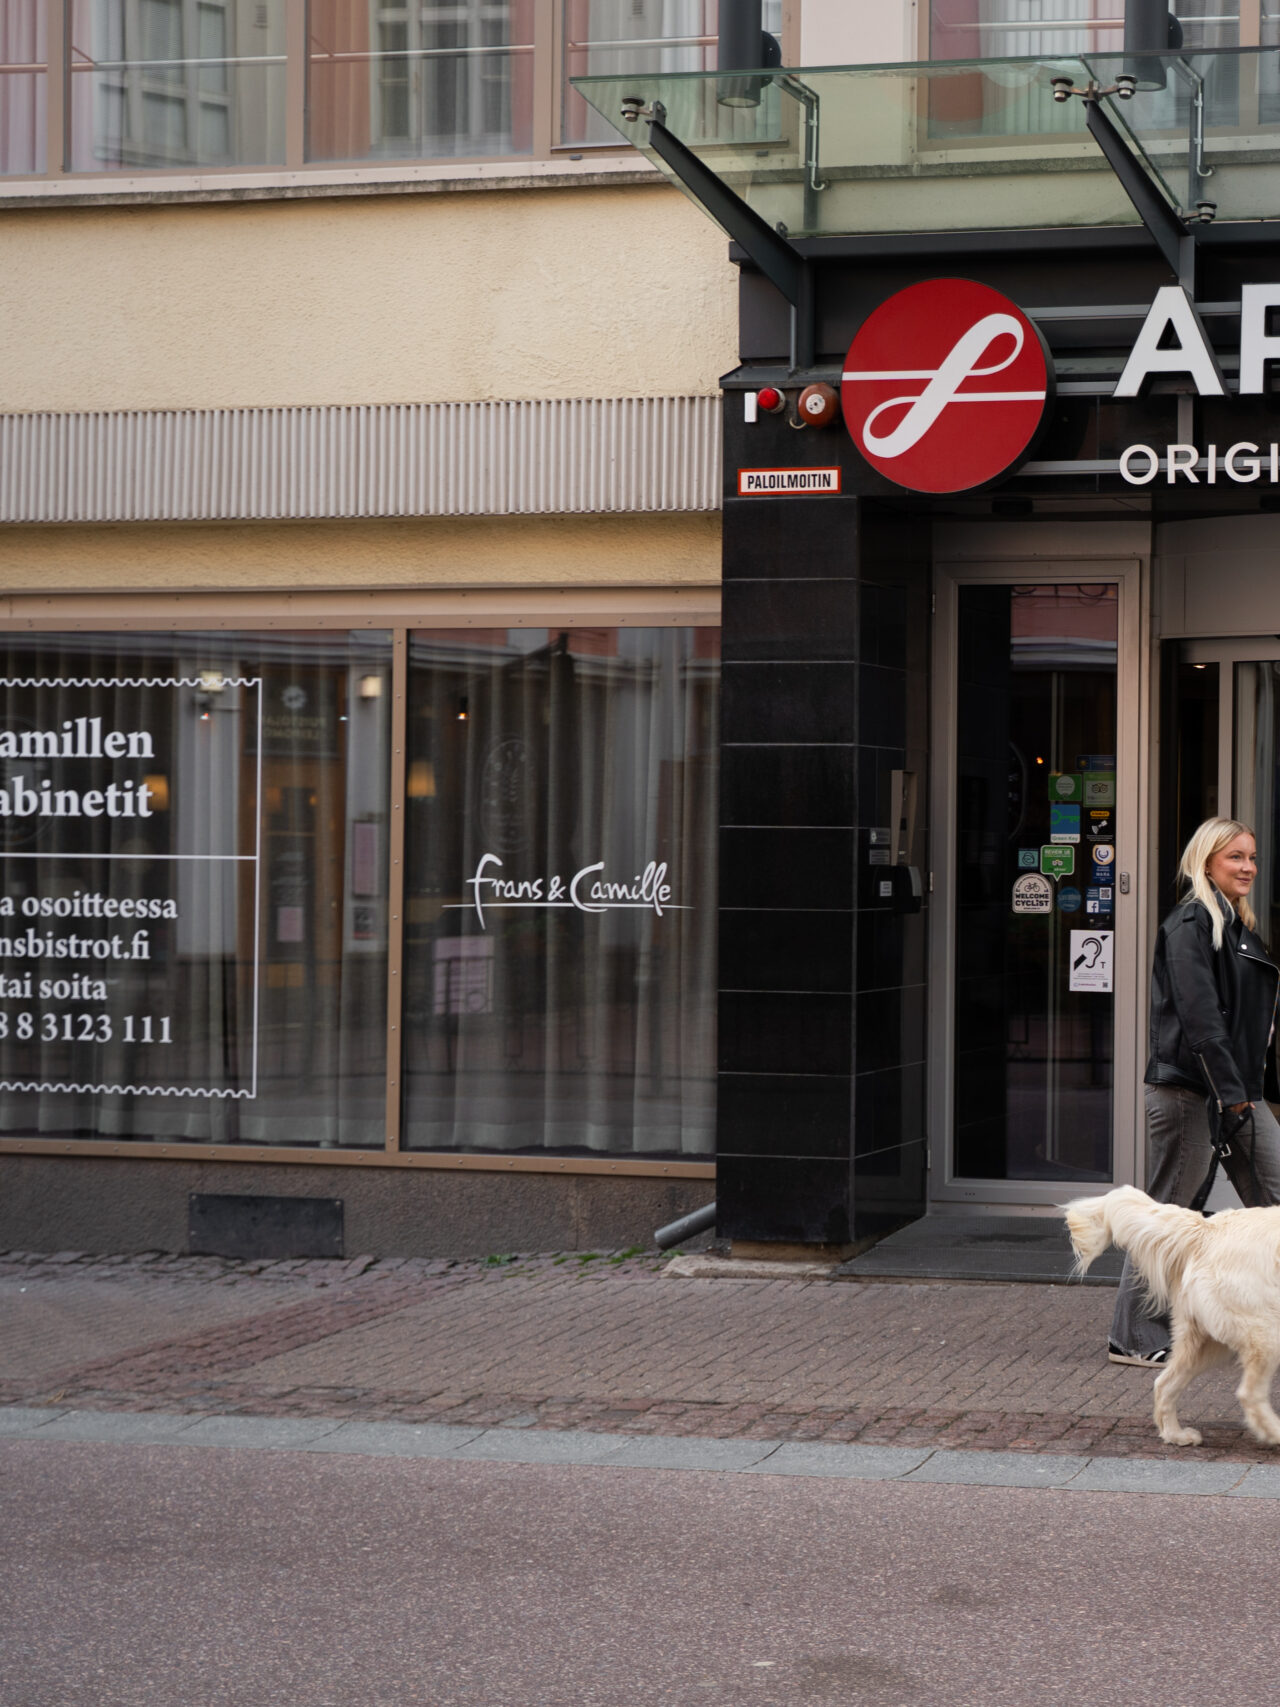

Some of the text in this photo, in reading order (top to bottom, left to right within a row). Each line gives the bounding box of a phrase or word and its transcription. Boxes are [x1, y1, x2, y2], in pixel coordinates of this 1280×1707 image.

[747, 473, 831, 489] PALOILMOITIN
[570, 861, 671, 917] Camille
[21, 890, 178, 919] osoitteessa
[39, 973, 108, 1000] soita
[16, 1012, 34, 1040] 8
[41, 1013, 113, 1043] 3123
[123, 1015, 173, 1044] 111
